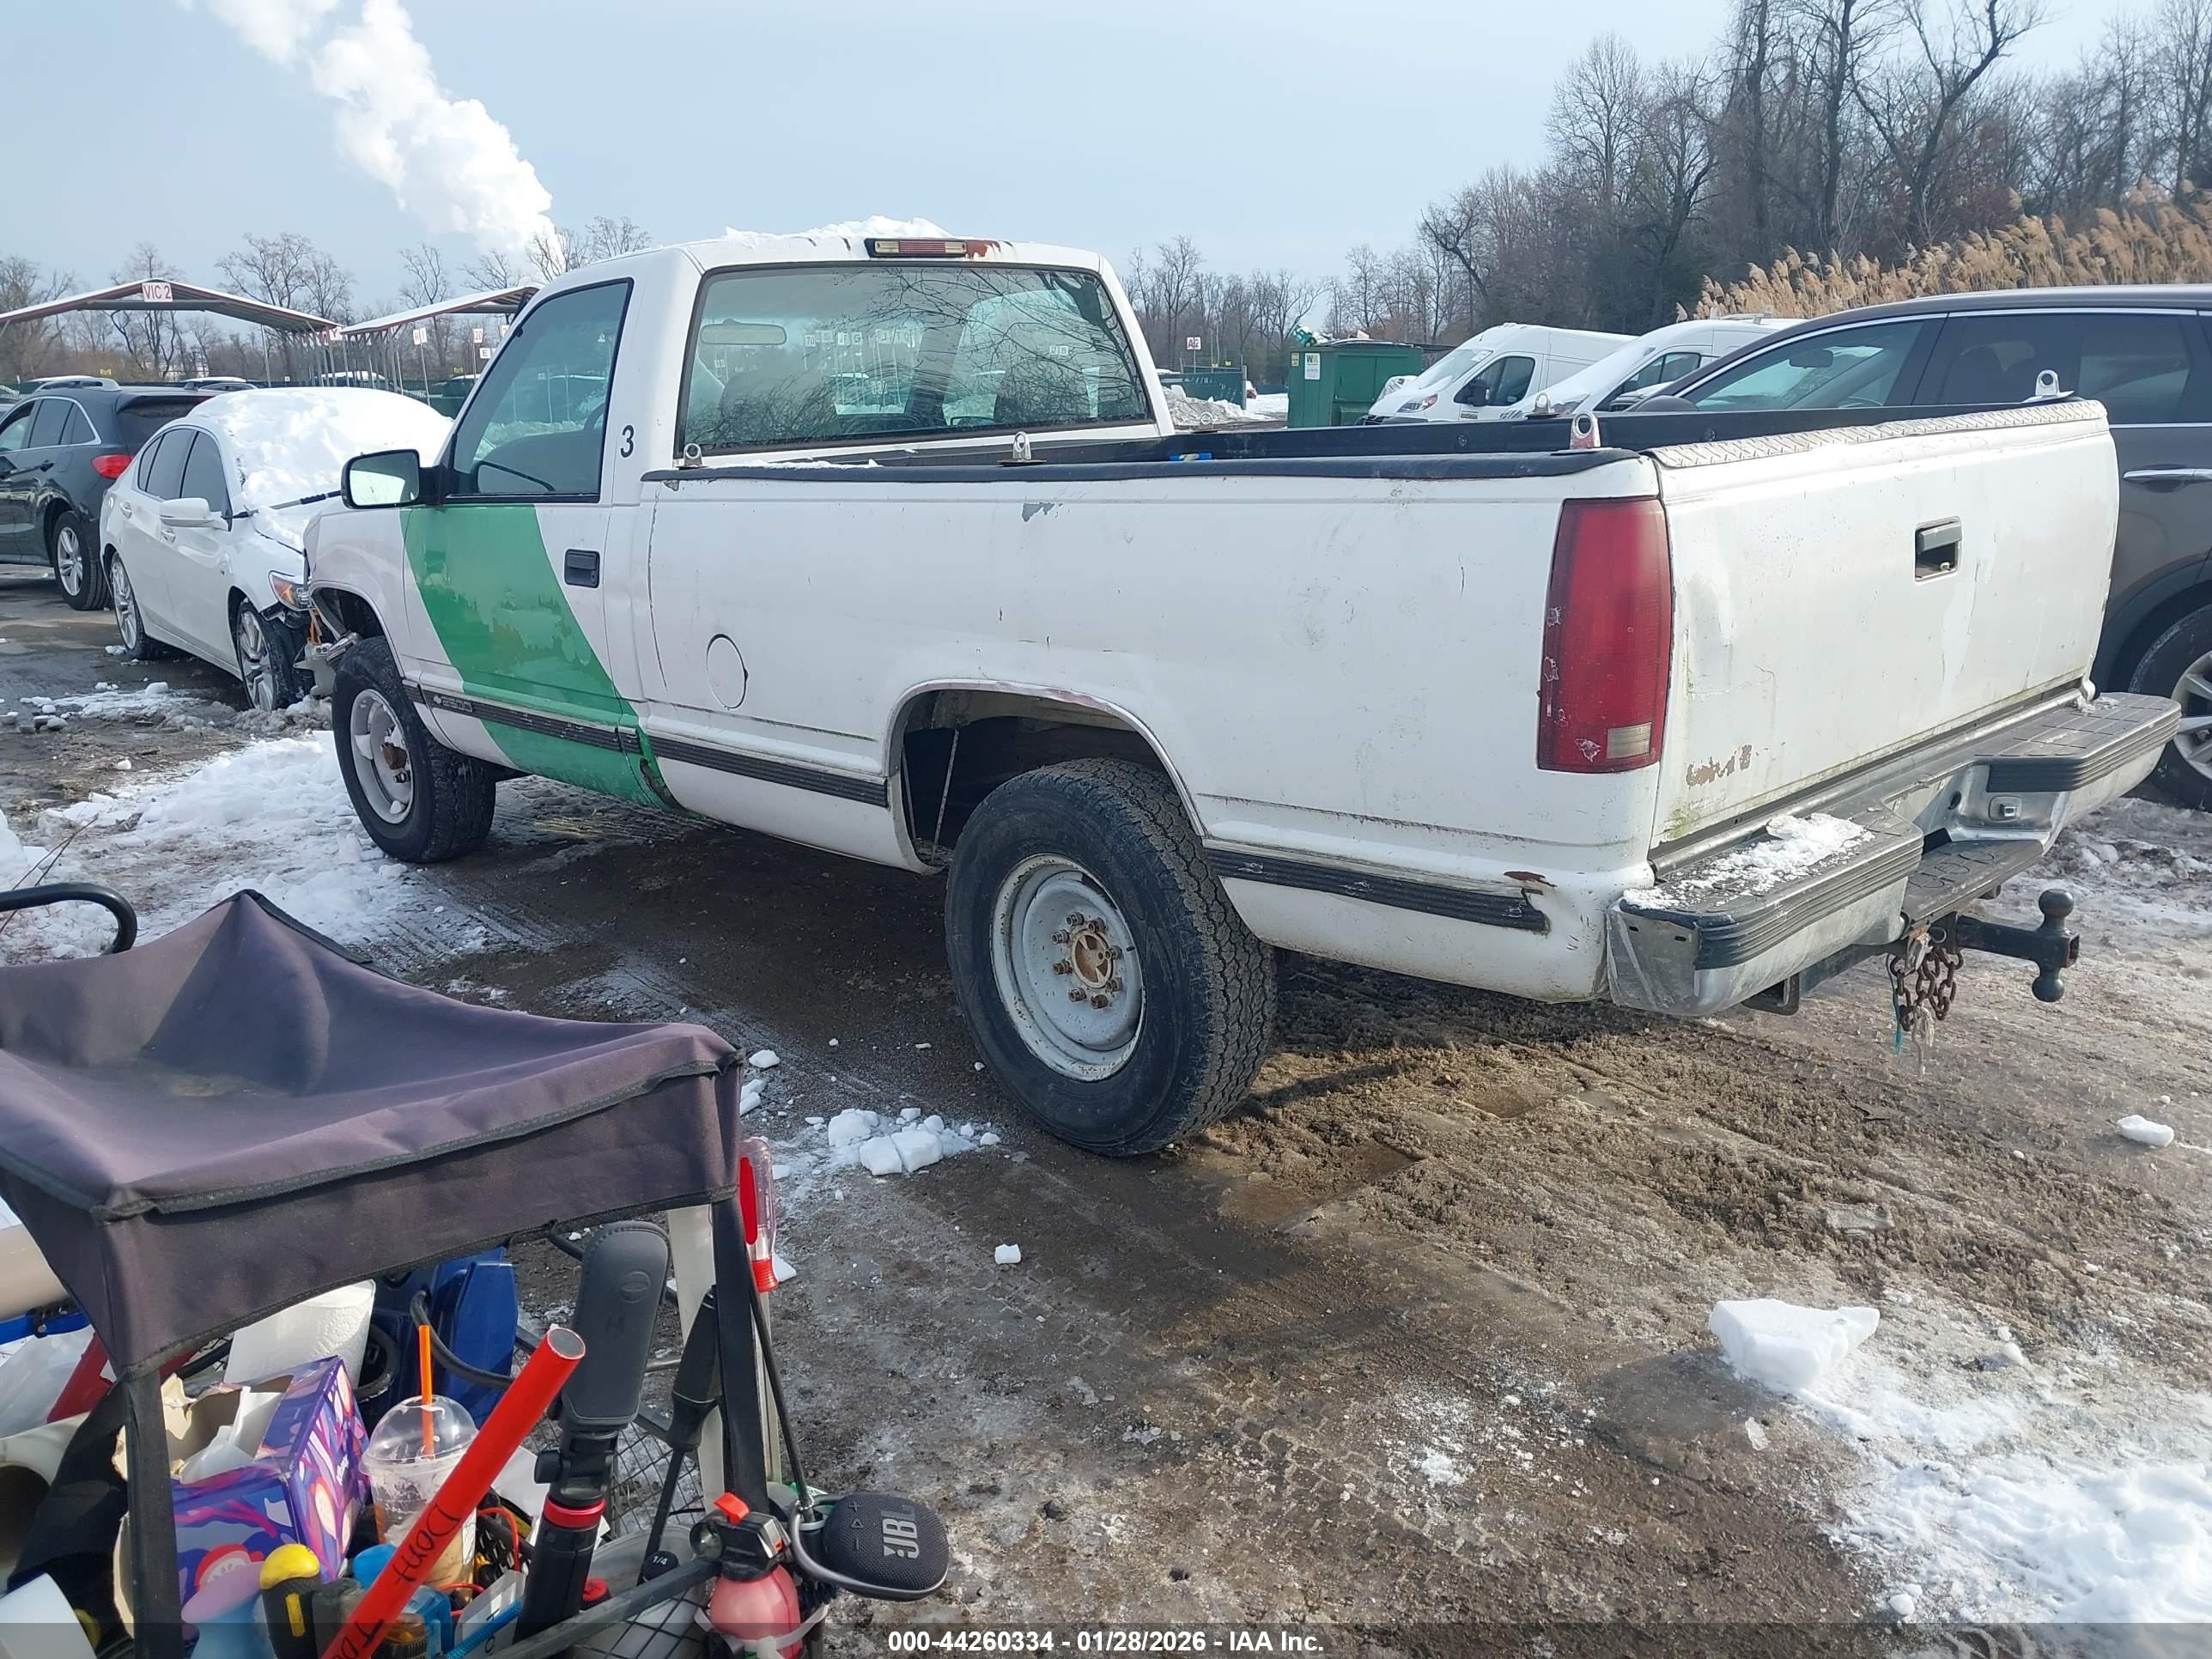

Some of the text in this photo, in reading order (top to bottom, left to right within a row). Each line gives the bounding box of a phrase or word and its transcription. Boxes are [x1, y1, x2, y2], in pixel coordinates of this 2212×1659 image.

[143, 285, 171, 300] VIC 2
[620, 424, 635, 458] 3
[441, 695, 473, 713] 2500
[881, 1504, 919, 1559] JBL
[653, 1555, 668, 1565] 1/4
